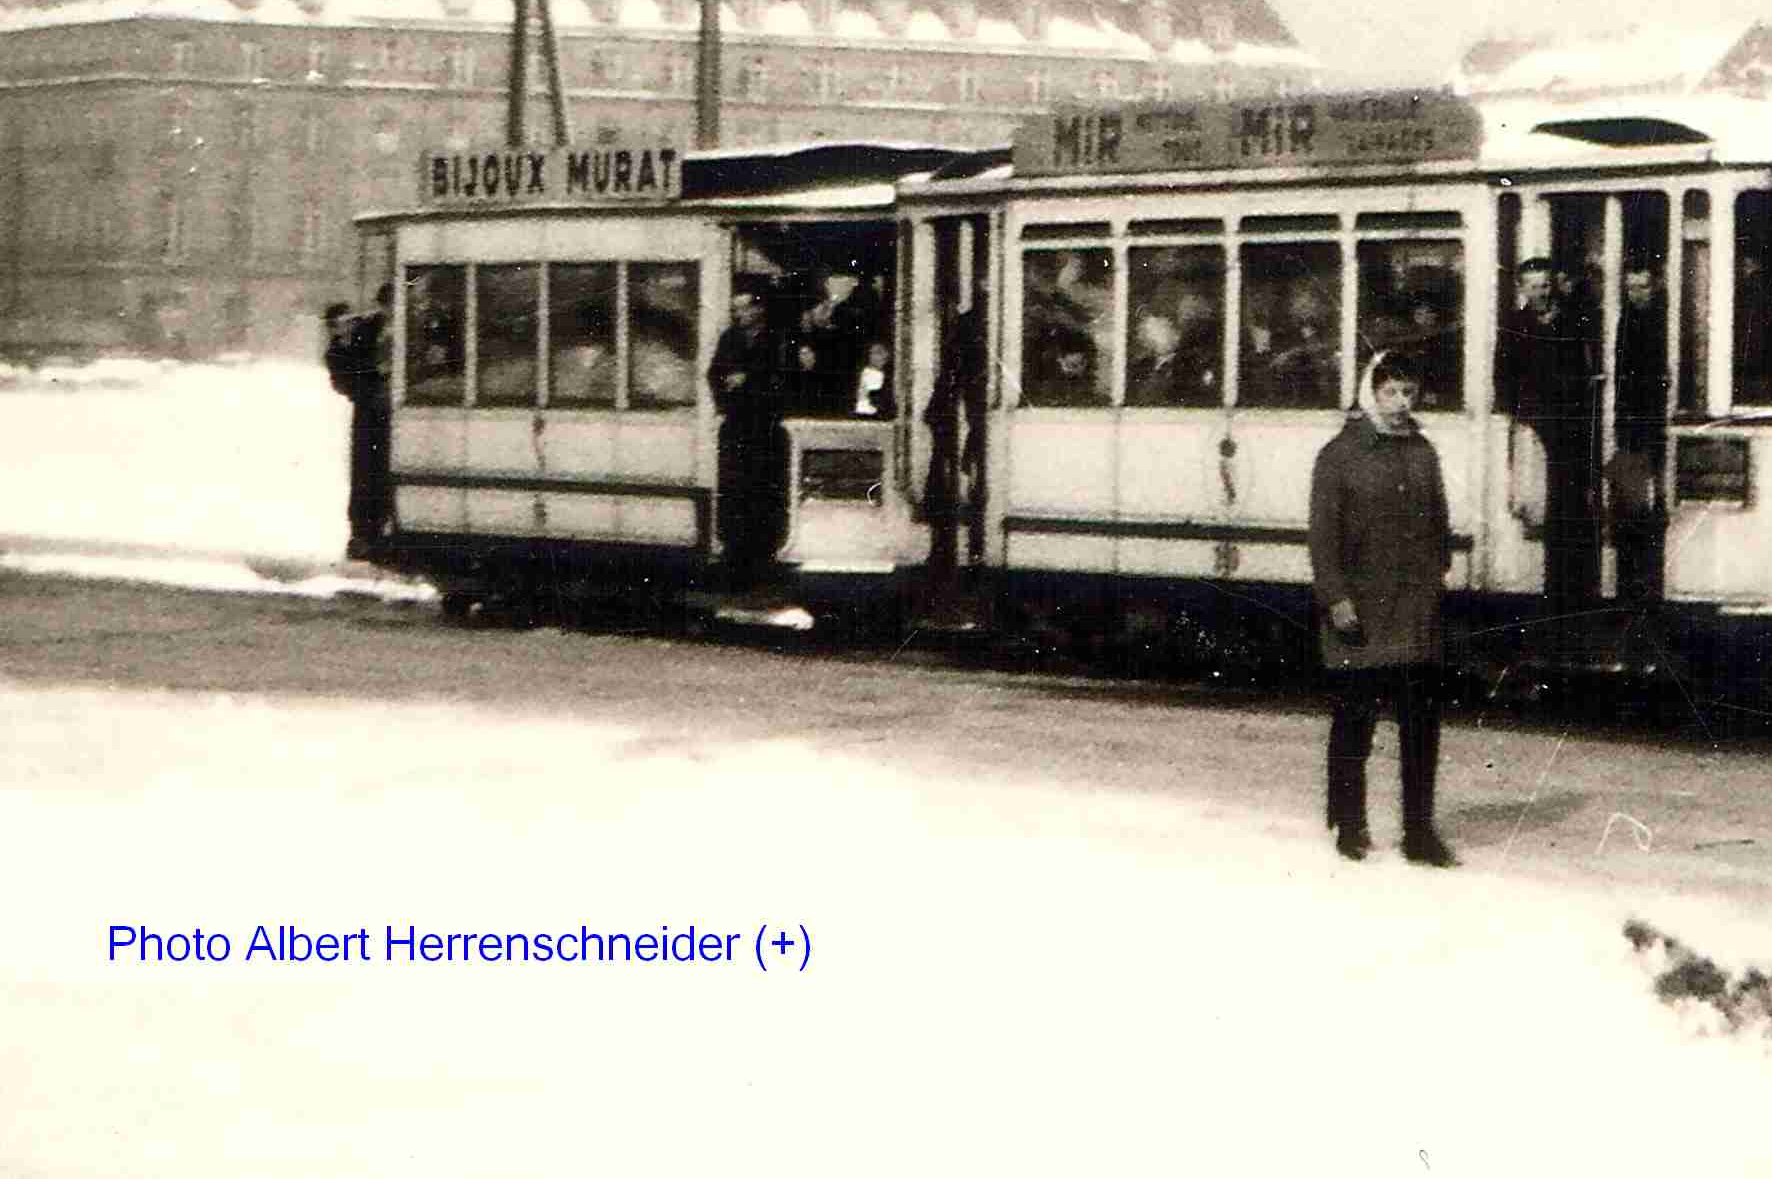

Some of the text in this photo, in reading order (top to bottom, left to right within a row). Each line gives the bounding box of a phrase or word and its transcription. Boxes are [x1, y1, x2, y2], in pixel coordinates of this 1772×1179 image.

[1241, 105, 1314, 156] MIR
[432, 149, 677, 196] BIJOUX MURAT
